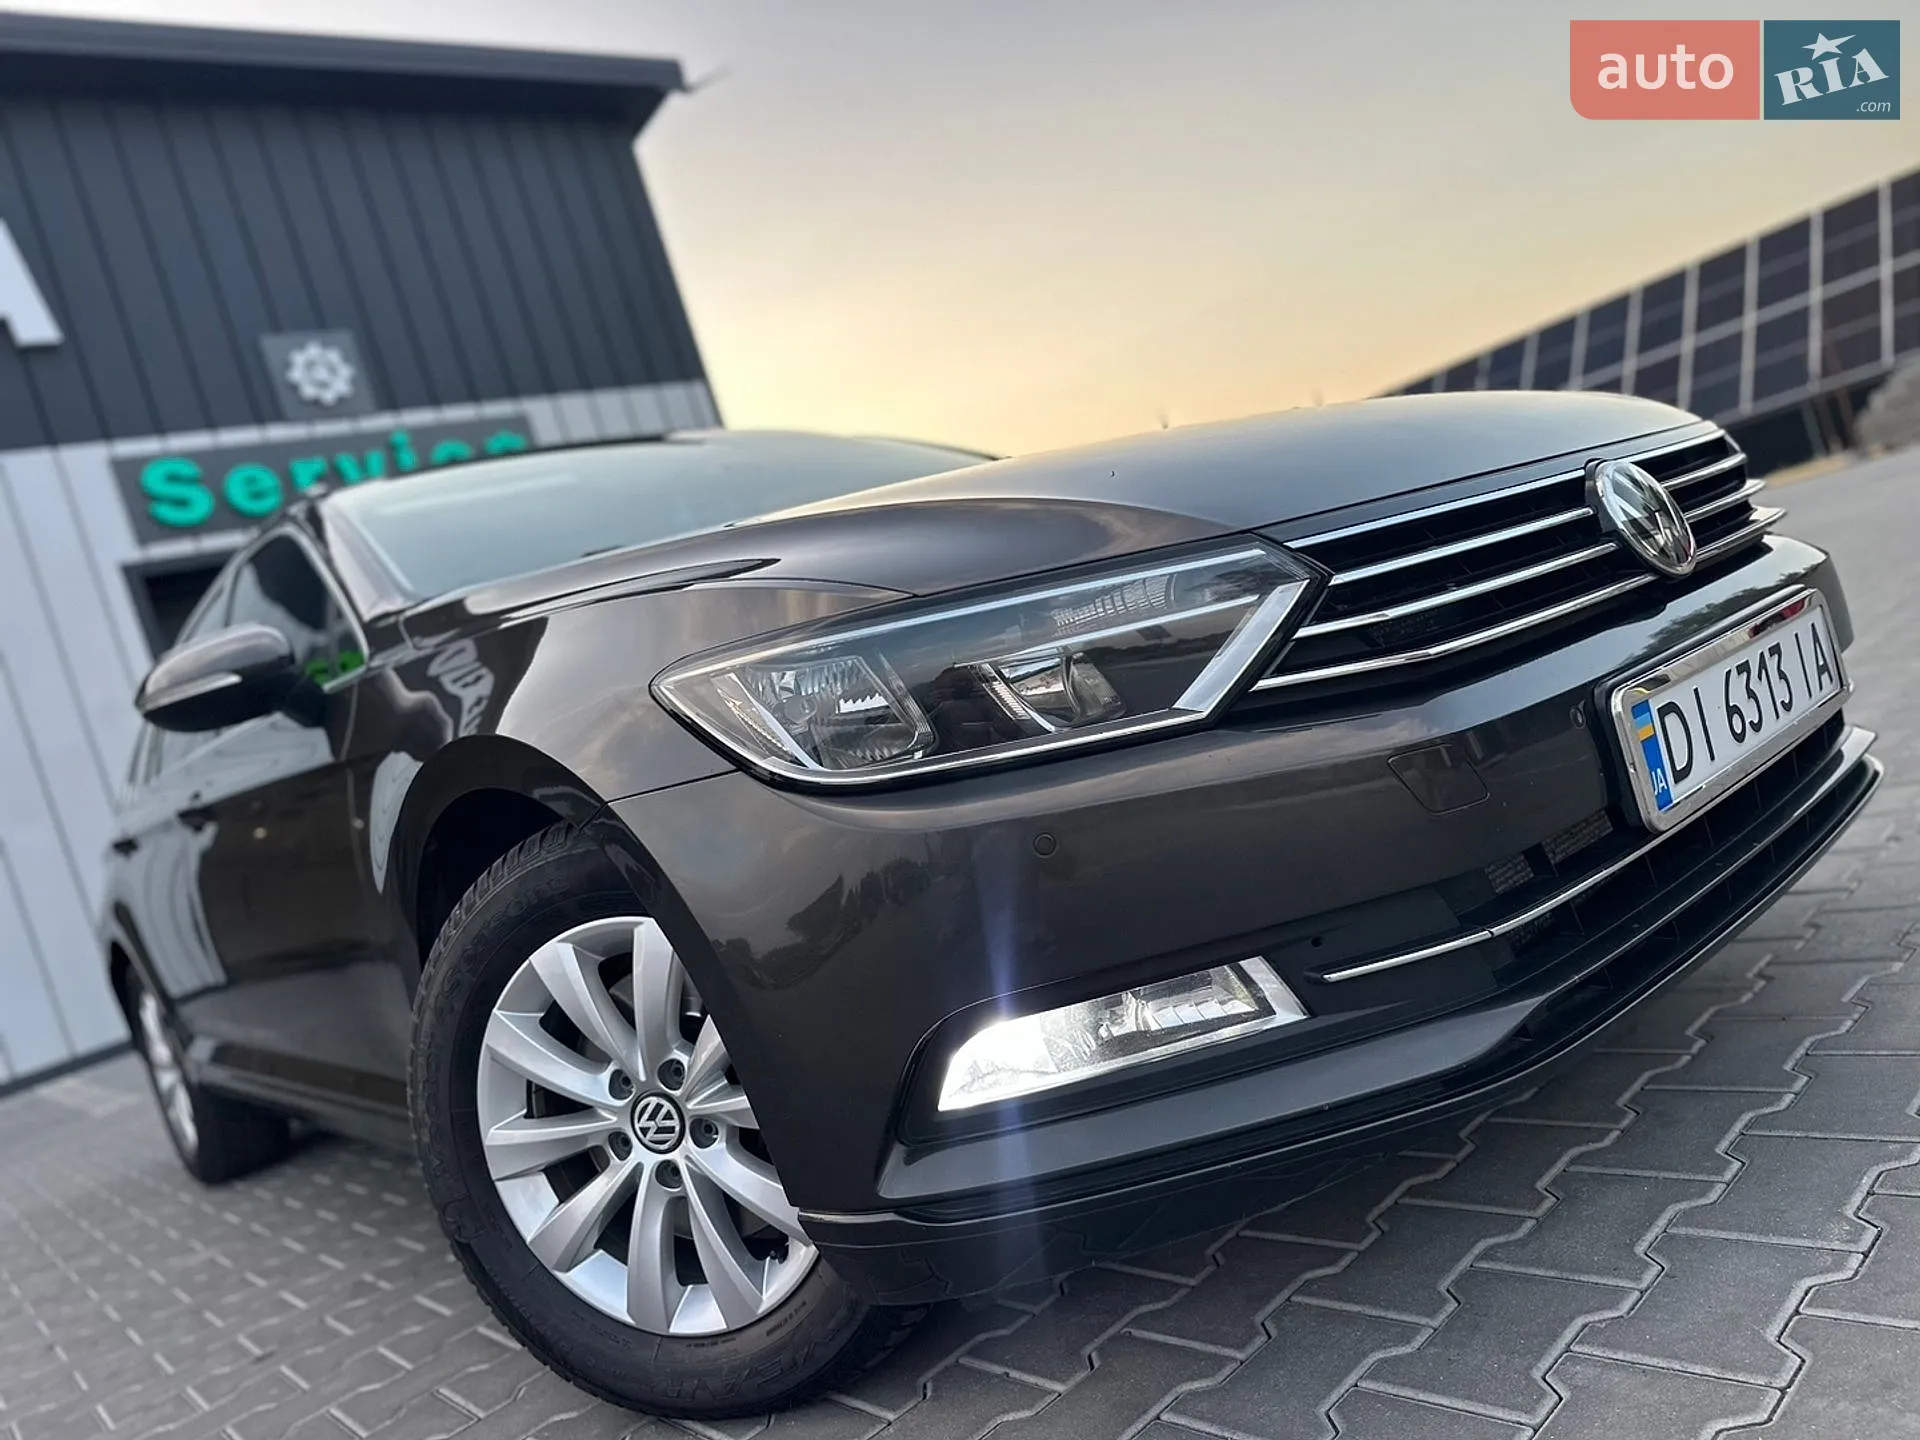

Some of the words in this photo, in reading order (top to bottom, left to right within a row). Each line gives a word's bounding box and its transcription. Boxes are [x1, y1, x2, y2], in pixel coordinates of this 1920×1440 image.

[1657, 686, 1716, 784] DI
[1724, 641, 1794, 744] 6313
[1794, 621, 1835, 699] IA
